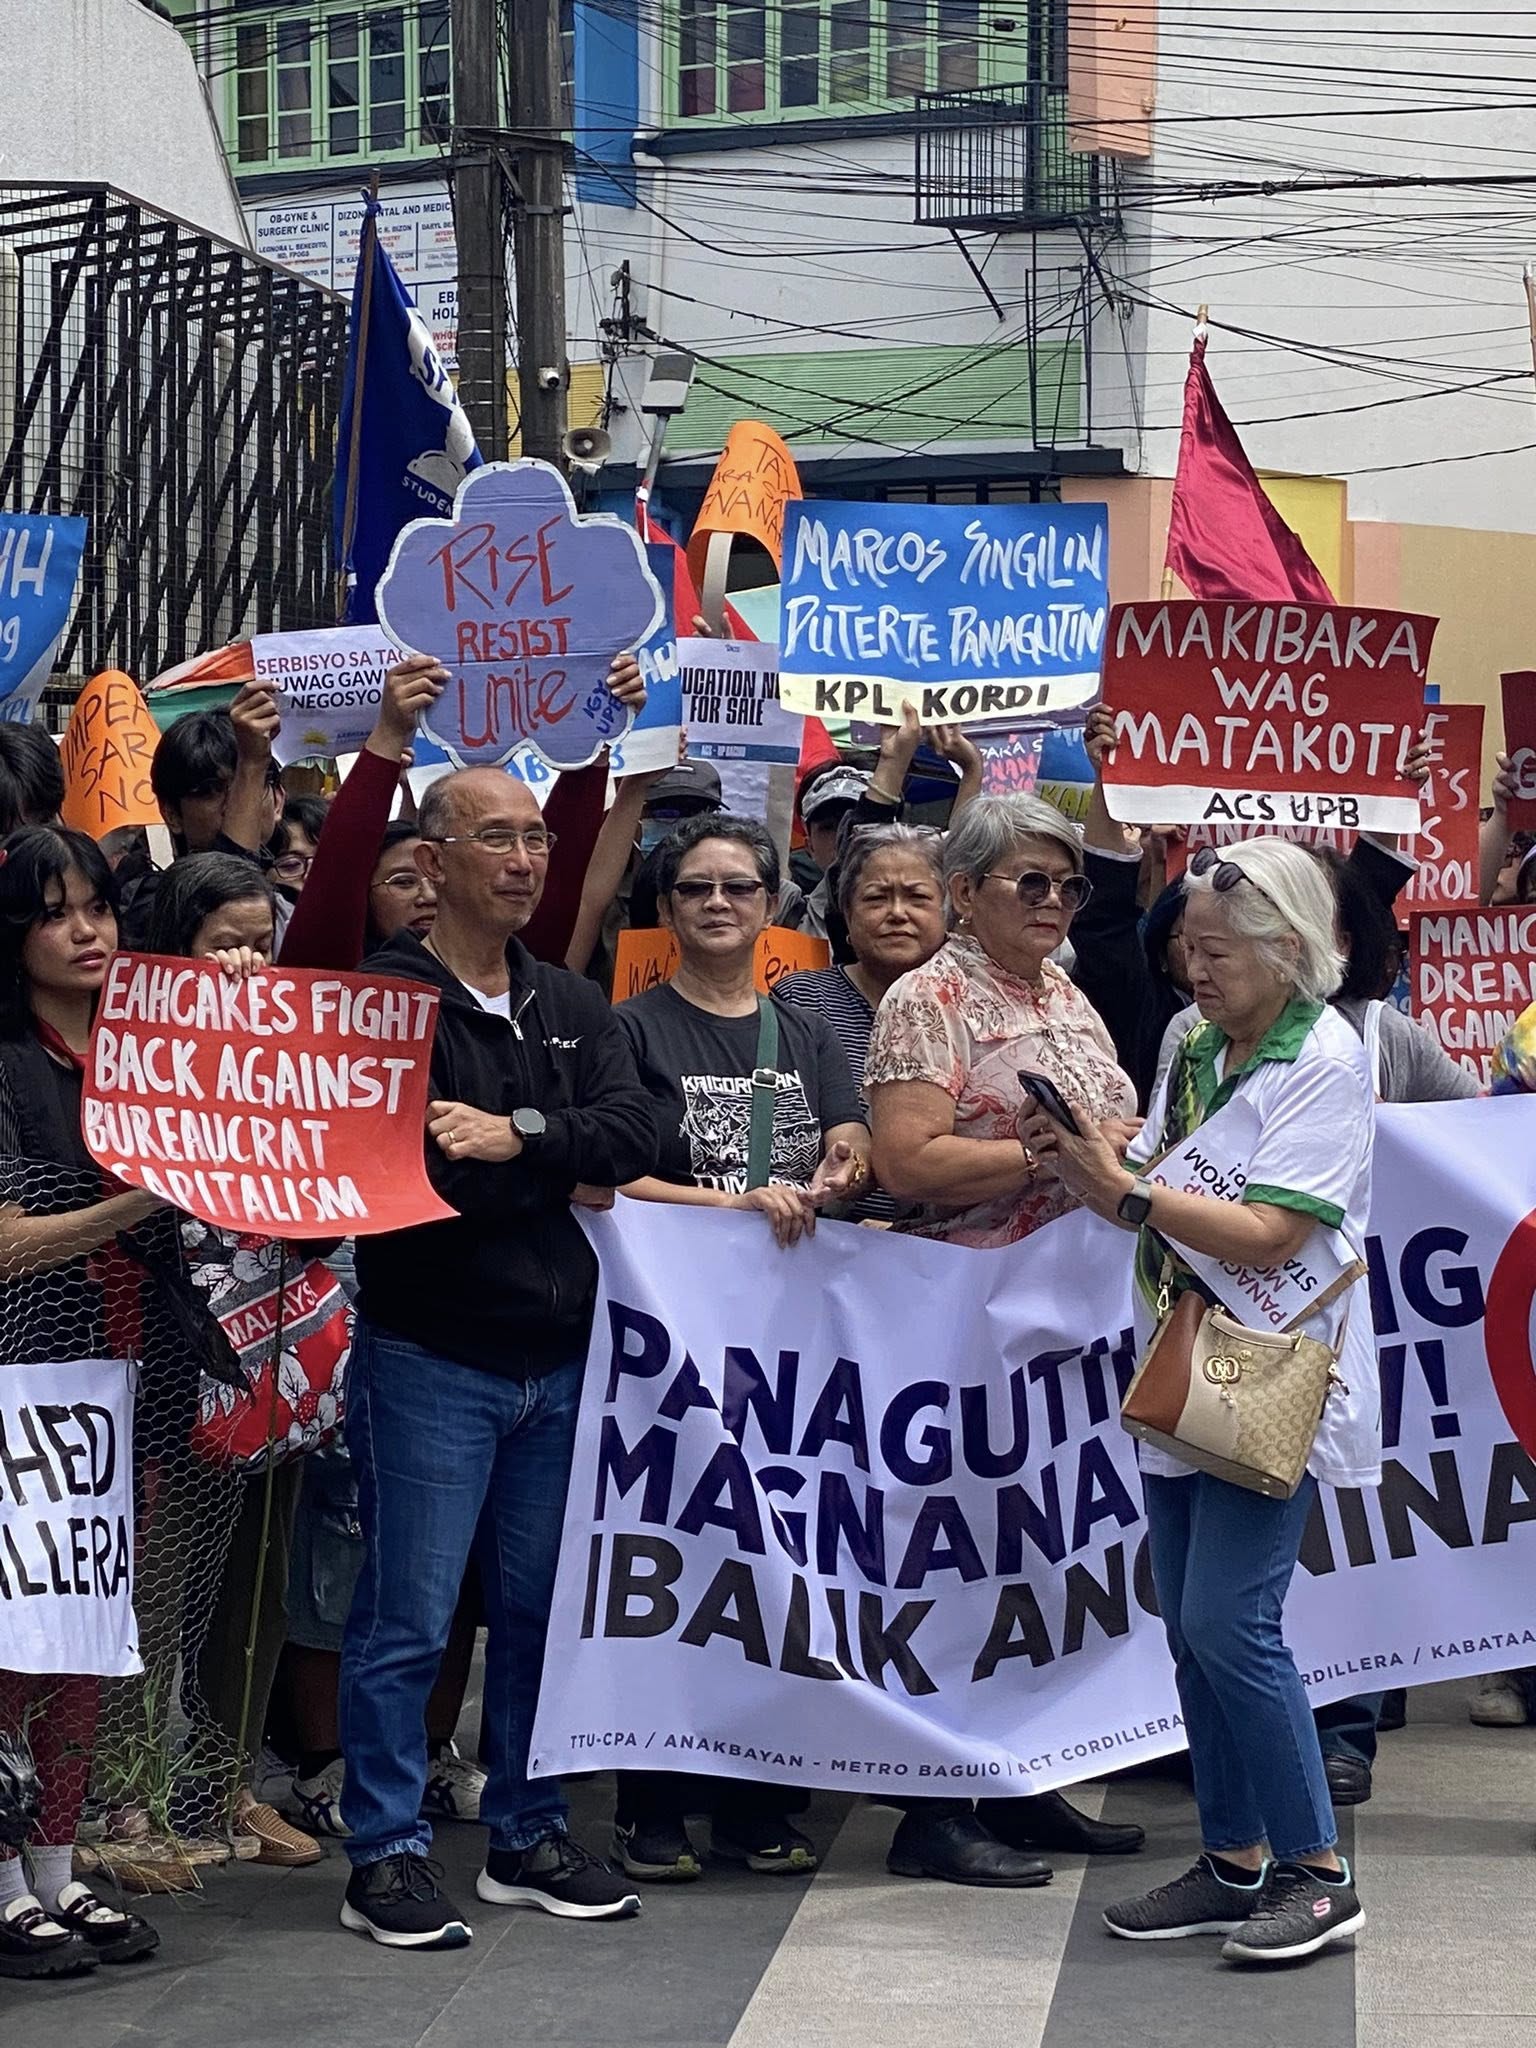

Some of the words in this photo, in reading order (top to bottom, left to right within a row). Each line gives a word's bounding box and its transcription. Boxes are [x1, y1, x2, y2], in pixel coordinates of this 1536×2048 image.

[257, 225, 299, 238] SURGERY
[300, 222, 330, 235] CLINIC
[270, 212, 308, 224] OB-GYNE
[310, 211, 317, 221] &
[338, 210, 364, 222] DIZON
[375, 206, 400, 217] NTAL
[401, 204, 420, 215] AND
[423, 202, 451, 213] MEDIC
[432, 308, 457, 320] HOL
[438, 291, 457, 304] EB
[428, 514, 574, 612] RISE
[788, 516, 946, 591] MARCOS
[960, 520, 1102, 590] SINGILIN
[456, 617, 571, 666] RESIST
[947, 602, 1106, 669] PANAGUTIN
[256, 653, 345, 675] SERBISYO
[350, 651, 372, 667] SA
[271, 671, 334, 693] UWAG
[679, 667, 756, 698] UCATION
[291, 689, 382, 710] NEGOSYO
[457, 663, 579, 747] Unite
[689, 695, 721, 724] FOR
[726, 697, 765, 726] SALE
[815, 680, 893, 717] KPL
[922, 683, 1050, 718] KORDI
[1211, 666, 1329, 717] WAG
[1107, 710, 1411, 781] MATAKOT!
[1202, 792, 1276, 821] ACS
[1290, 794, 1360, 827] UPB
[102, 957, 297, 1036] EAHCAKES
[311, 980, 440, 1041] FIGHT
[1420, 962, 1536, 1004] DREA
[94, 1027, 205, 1101] BACK
[216, 1043, 416, 1115] AGAINST
[84, 1097, 330, 1171] BUREAUCRAT
[0, 1402, 116, 1506] HED
[594, 1415, 1148, 1590] MAGNANA
[580, 1533, 940, 1697] IBALIK
[570, 1732, 637, 1750] TTU-CPA
[664, 1734, 804, 1768] ANAKBAYAN
[831, 1759, 909, 1776] METRO
[918, 1762, 1001, 1778] BAGUIO
[1018, 1753, 1053, 1776] ACT
[1061, 1713, 1185, 1762] CORDILLERA
[1299, 1651, 1405, 1688] RDILLERA
[1431, 1629, 1536, 1660] KABATAA
